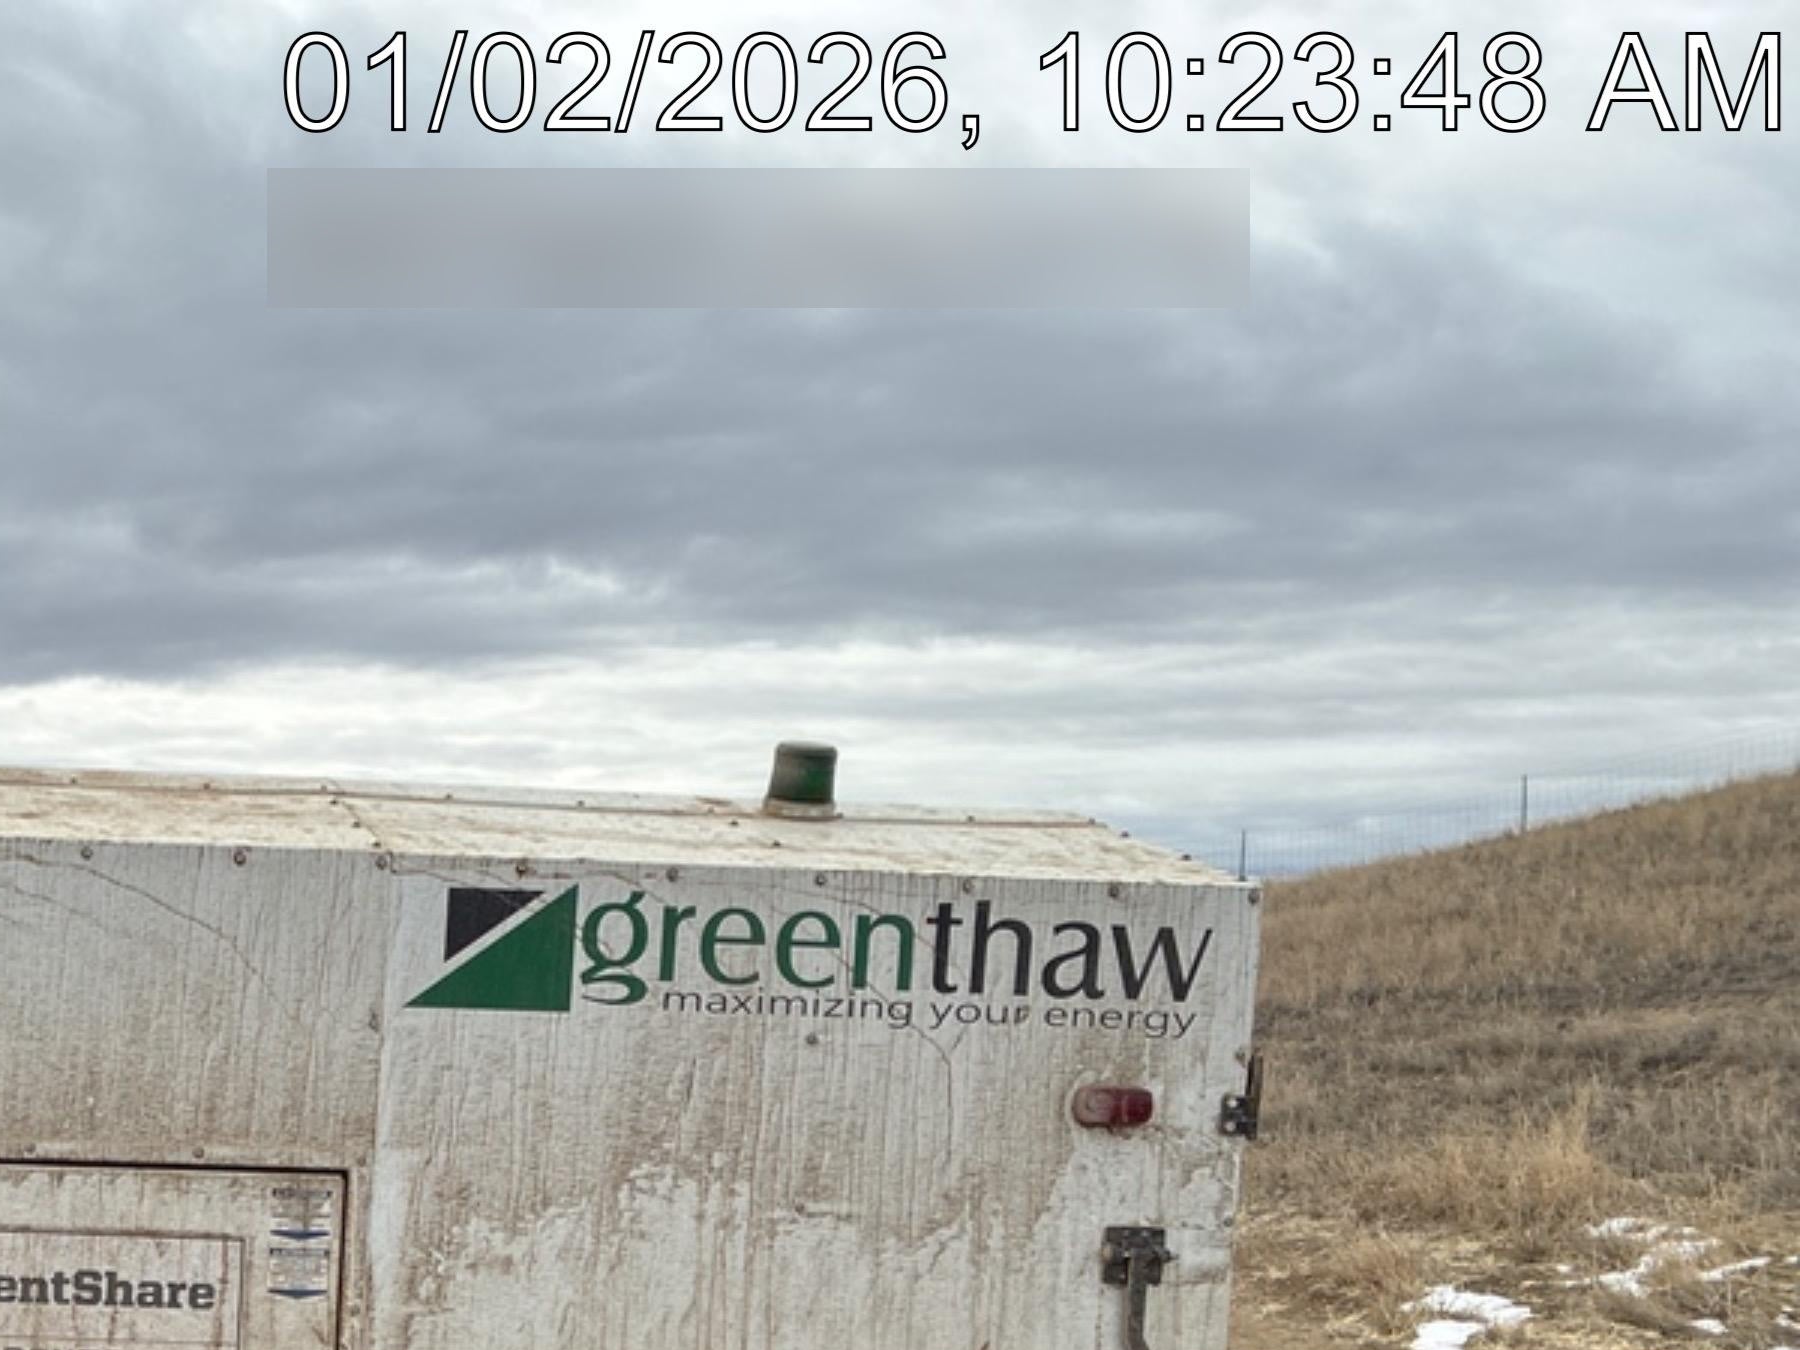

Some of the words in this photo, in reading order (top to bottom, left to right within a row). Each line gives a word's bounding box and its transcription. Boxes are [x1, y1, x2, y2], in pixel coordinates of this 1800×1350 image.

[579, 890, 1214, 1006] greenthaw
[662, 986, 913, 1028] maximizing
[928, 1000, 1032, 1030] your
[1043, 1003, 1198, 1039] energy
